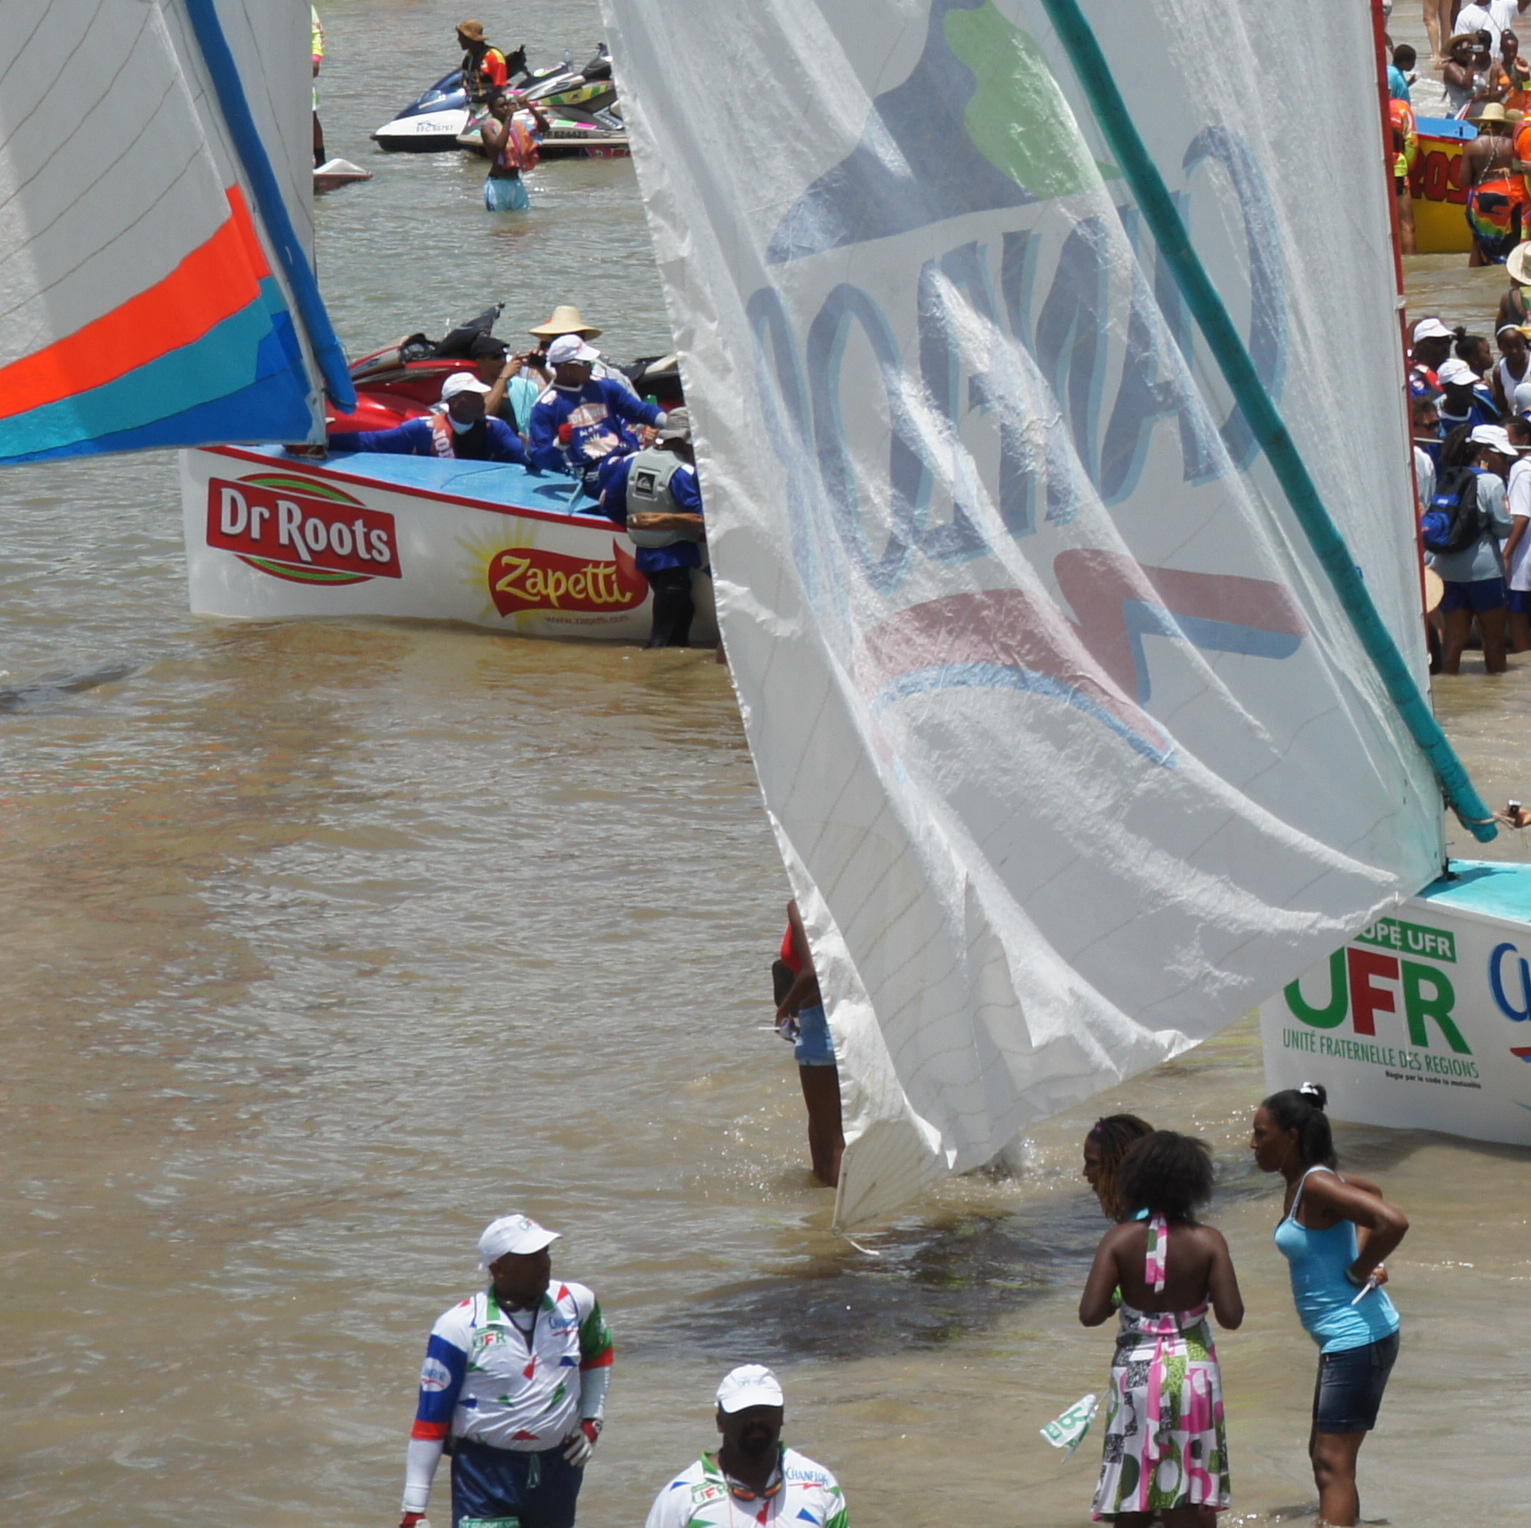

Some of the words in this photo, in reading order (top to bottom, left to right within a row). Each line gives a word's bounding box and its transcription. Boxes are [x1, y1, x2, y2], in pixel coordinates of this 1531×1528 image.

[219, 486, 270, 540] Dr
[277, 498, 392, 564] Roots
[495, 554, 633, 609] Zapetti
[1407, 930, 1454, 958] UFR
[1284, 945, 1474, 1056] UFR
[1283, 1028, 1317, 1054] UNITÉ
[1319, 1036, 1396, 1068] FRATERNELLE
[1398, 1049, 1422, 1072] DES
[1424, 1055, 1480, 1080] REGIONS
[1405, 1074, 1416, 1083] par
[1425, 1076, 1440, 1085] code
[692, 1484, 727, 1505] UFR
[785, 1467, 830, 1485] CHANFLOR
